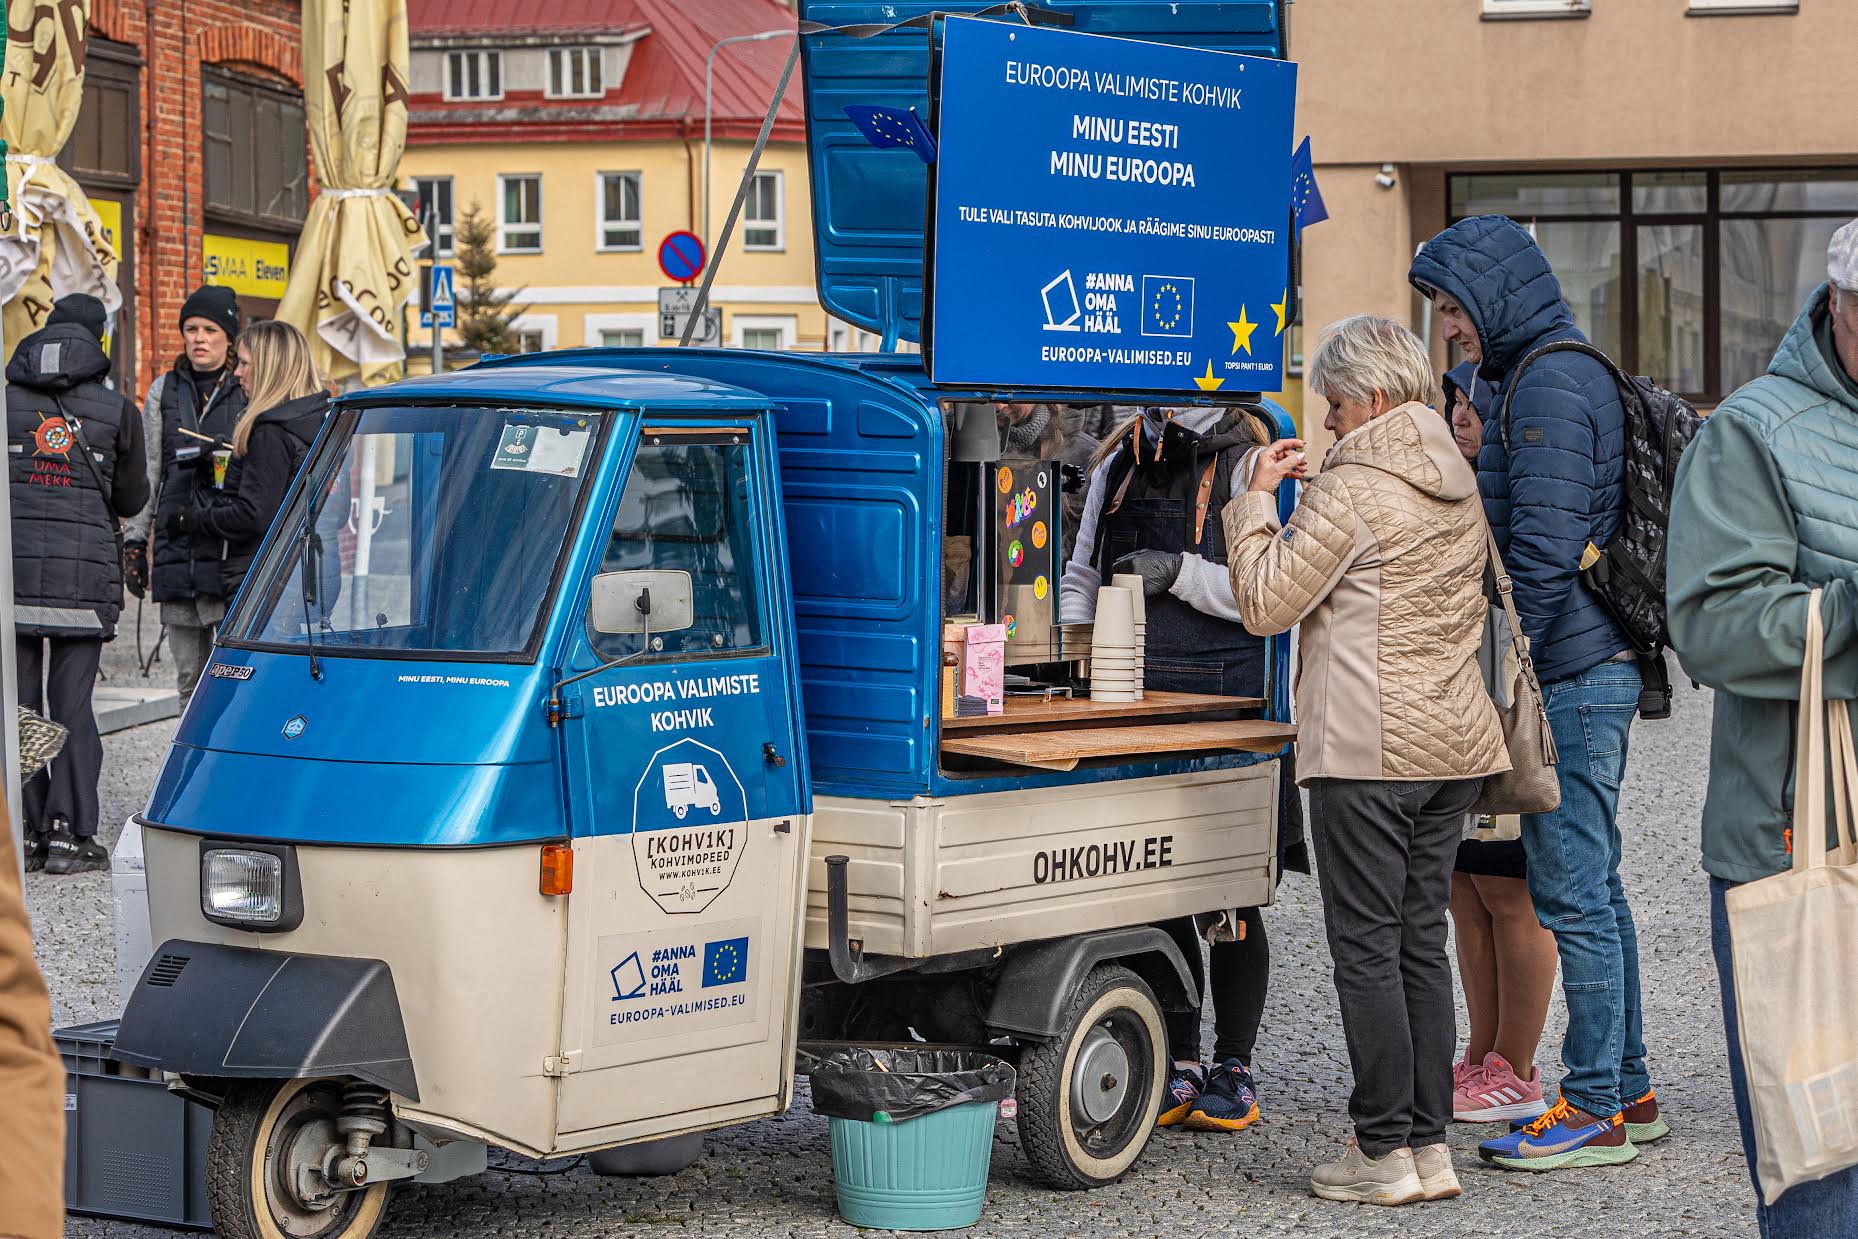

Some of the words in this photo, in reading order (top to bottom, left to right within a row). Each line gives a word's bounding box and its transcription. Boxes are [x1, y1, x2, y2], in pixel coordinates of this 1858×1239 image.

[1006, 61, 1091, 92] EUROOPA
[1095, 71, 1178, 102] VALIMISTE
[1182, 82, 1242, 109] KOHVIK
[1072, 115, 1124, 143] MINU
[1128, 121, 1179, 149] EESTI
[1050, 151, 1102, 179] MINU
[1106, 156, 1196, 187] EUROOPA
[959, 206, 988, 223] TULE
[989, 208, 1014, 224] VALI
[1015, 211, 1057, 227] TASUTA
[1058, 213, 1123, 232] KOHVIJOOK
[1123, 219, 1137, 233] JA
[1138, 216, 1186, 237] RÄÄGIME
[1187, 224, 1212, 240] SINU
[1213, 226, 1275, 244] EUROOPAST!
[256, 259, 285, 281] Eleven
[1085, 272, 1135, 292] #ANNA
[1085, 292, 1117, 312] OMA
[1084, 311, 1122, 333] HÄÄL
[1041, 346, 1192, 366] EUROOPA-VALIMISED.EU
[1225, 361, 1240, 370] TOPSI
[1241, 362, 1255, 370] PANT
[1258, 363, 1273, 371] EURO
[34, 460, 71, 475] UMA
[29, 473, 71, 487] MEKK
[398, 675, 420, 683] MINU
[420, 675, 445, 684] EESTI,
[446, 676, 469, 684] MINU
[469, 677, 510, 687] EUROOPA
[593, 681, 676, 708] EUROOPA
[677, 674, 760, 699] VALIMISTE
[651, 707, 714, 732] KOHVIK
[647, 828, 734, 859] [KOHV1K]
[650, 850, 730, 869] KOHVIMOPEED
[1033, 835, 1173, 884] OHKOHV.EE
[652, 945, 696, 962] #ANNA
[651, 963, 680, 979] OMA
[650, 977, 683, 996] HÄÄL
[610, 993, 746, 1025] EUROOPA-VALIMISED.EU
